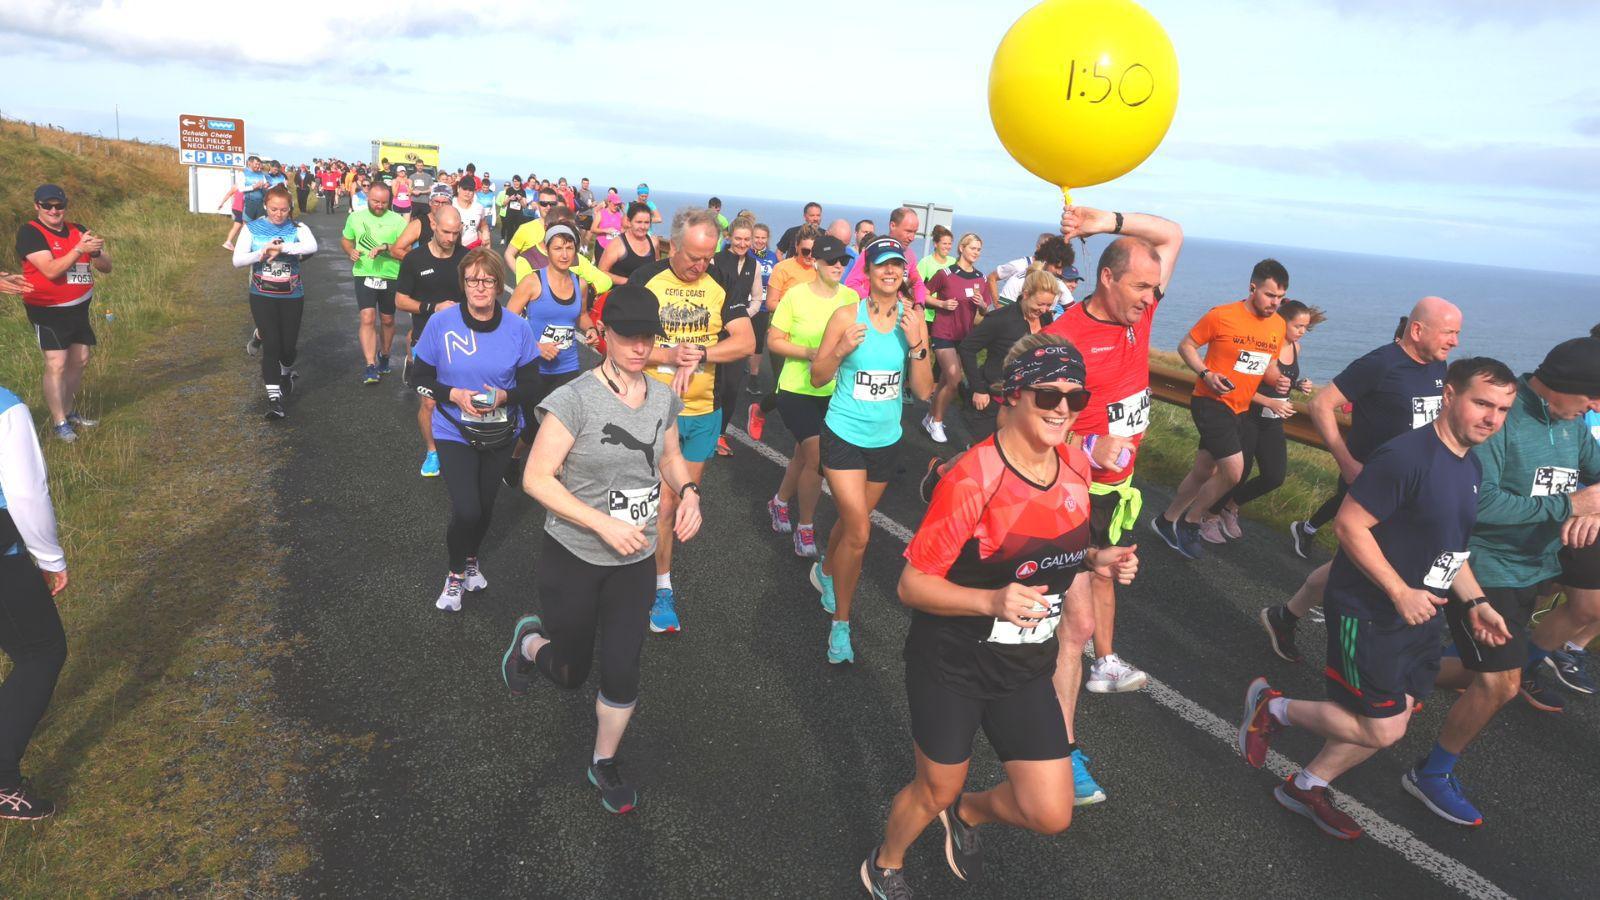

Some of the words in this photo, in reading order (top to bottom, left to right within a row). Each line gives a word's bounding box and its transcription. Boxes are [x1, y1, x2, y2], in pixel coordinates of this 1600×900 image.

[1066, 58, 1154, 107] 1:50
[187, 143, 225, 151] NEOLITHIC
[206, 138, 231, 146] FIELDS
[71, 274, 92, 283] 7053
[664, 288, 684, 297] CEIDE
[685, 289, 706, 298] COAST
[1044, 346, 1069, 355] GTC
[1246, 360, 1261, 371] 22
[870, 383, 887, 396] 85
[1126, 408, 1143, 427] 42
[630, 501, 648, 520] 60
